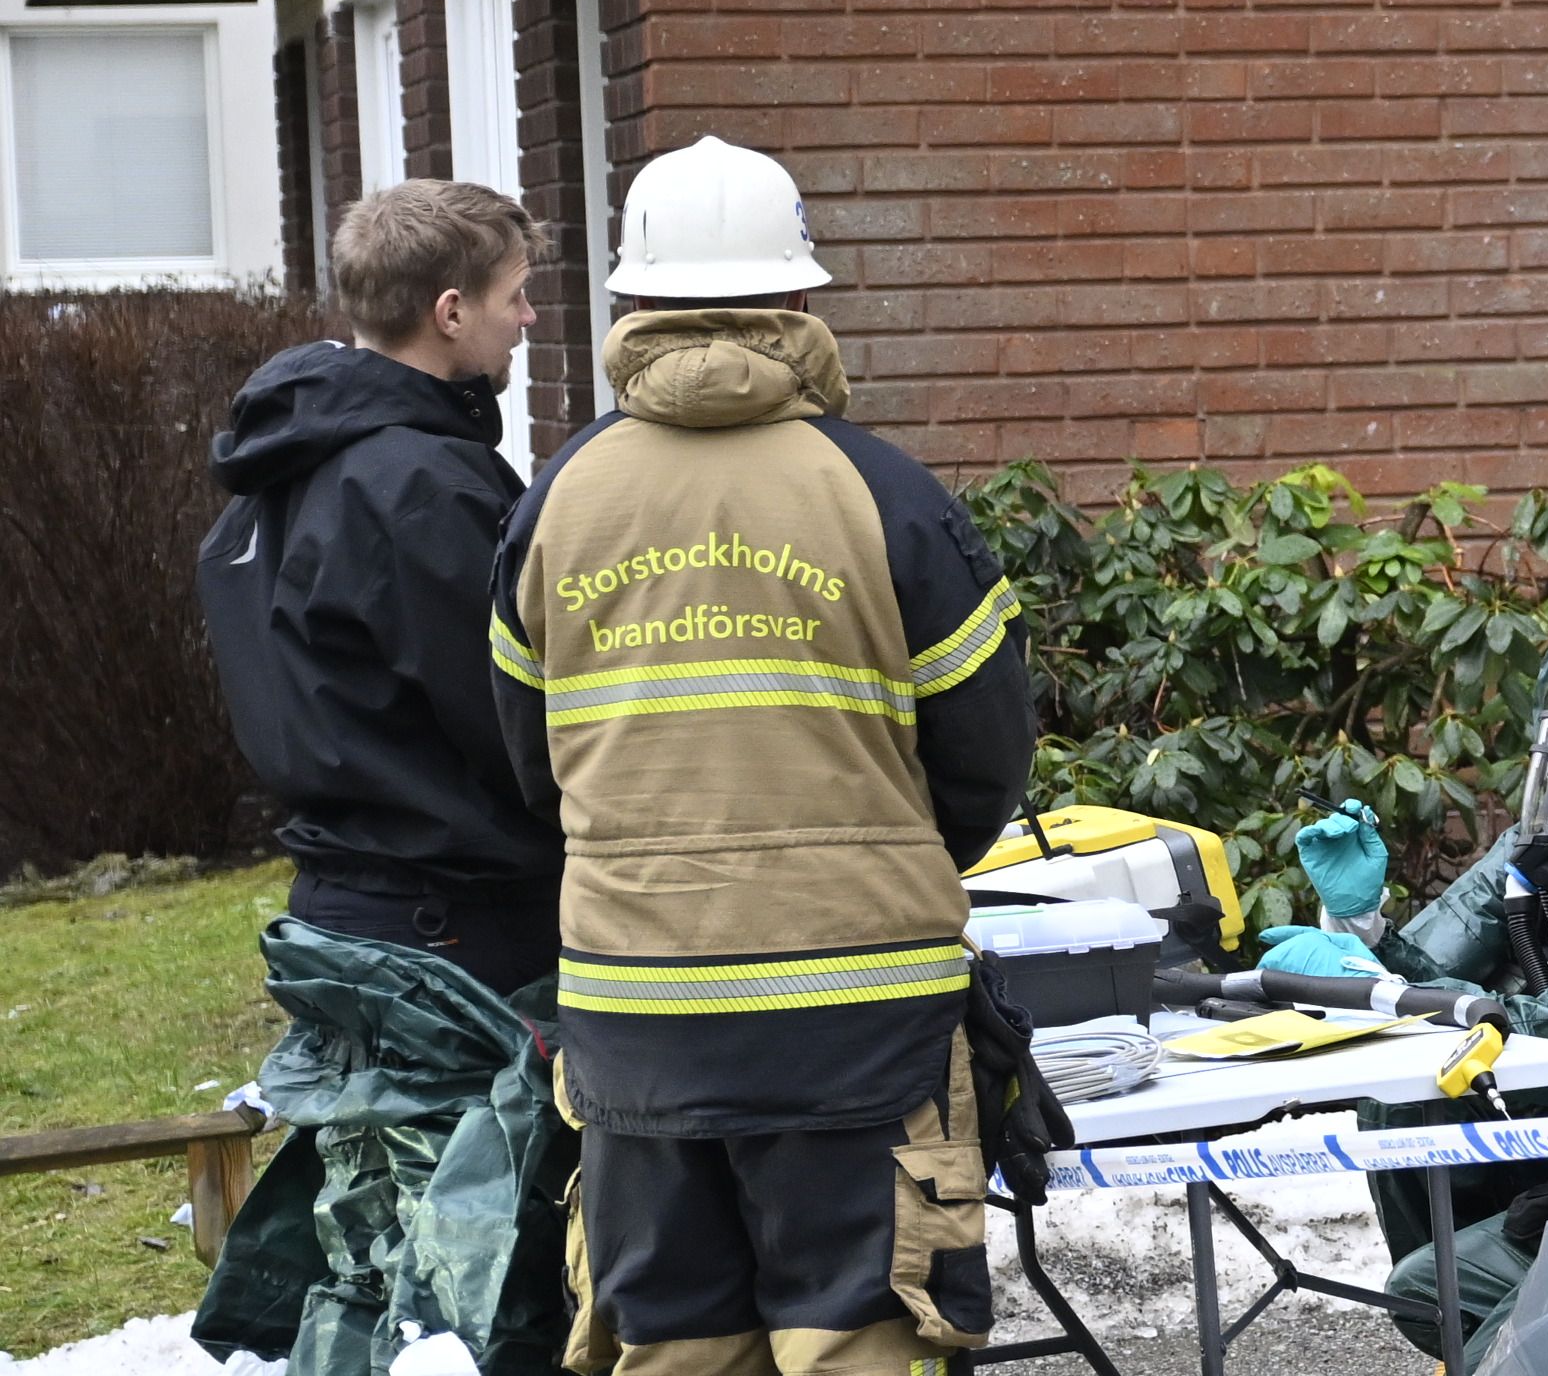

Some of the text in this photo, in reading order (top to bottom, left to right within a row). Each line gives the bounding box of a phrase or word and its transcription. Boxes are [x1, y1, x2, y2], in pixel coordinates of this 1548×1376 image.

[555, 531, 847, 613] Storstockholms
[588, 604, 821, 654] brandförsvar
[1047, 1162, 1086, 1189] PÄRRAT
[1222, 1147, 1276, 1179] POLIS
